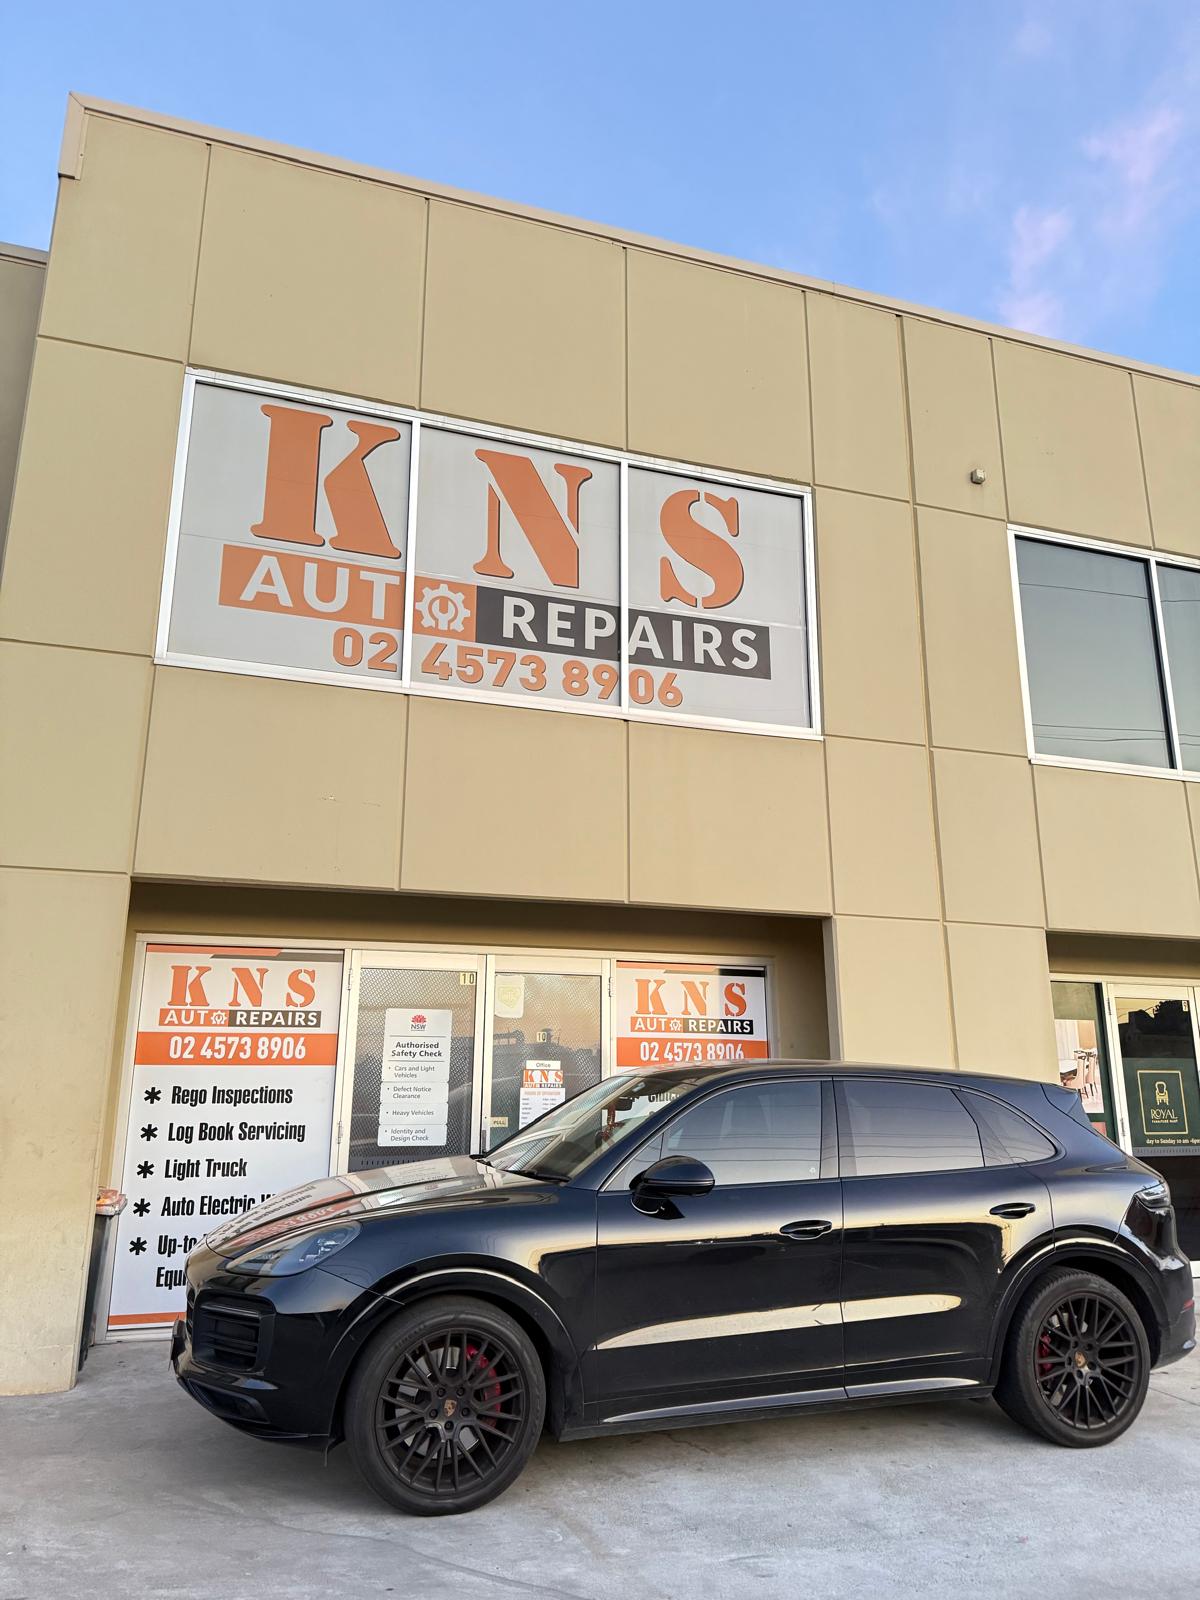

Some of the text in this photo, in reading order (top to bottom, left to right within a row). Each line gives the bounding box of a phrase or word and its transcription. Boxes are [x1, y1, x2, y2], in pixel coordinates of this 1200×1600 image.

[503, 596, 759, 671] REPAIRS
[333, 627, 683, 708] 02 4573 8906
[462, 973, 475, 985] 10
[235, 1011, 318, 1027] REPAIRS
[688, 1019, 751, 1034] REPAIRS
[169, 1036, 307, 1060] 02 4573 8906
[391, 1050, 417, 1058] Safety
[395, 1041, 440, 1049] Authorised
[640, 1041, 660, 1062] 02
[663, 1042, 702, 1062] 4573
[171, 1086, 293, 1107] Rego Inspections
[1151, 1109, 1178, 1120] ROYAL
[168, 1121, 306, 1144] Log Book Servicing
[164, 1158, 247, 1181] Light Truck
[161, 1196, 195, 1216] Auto
